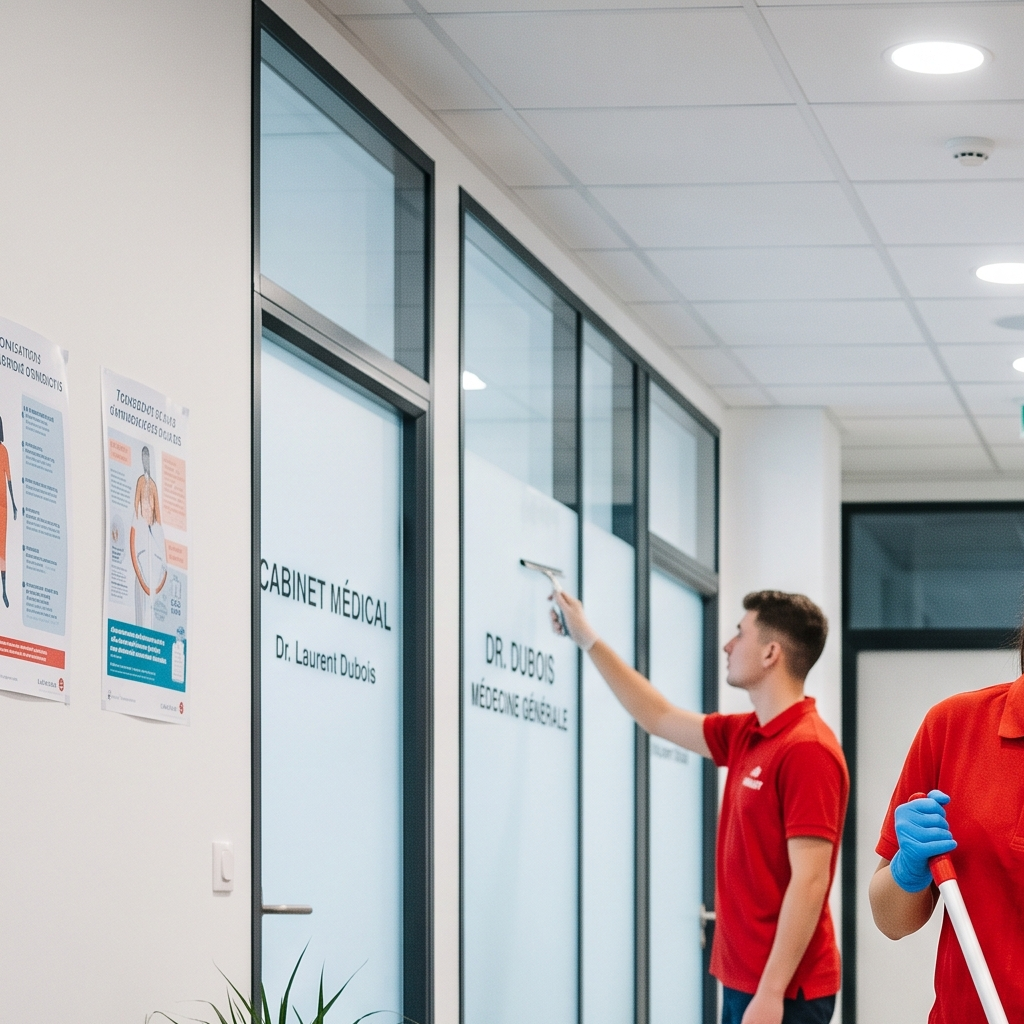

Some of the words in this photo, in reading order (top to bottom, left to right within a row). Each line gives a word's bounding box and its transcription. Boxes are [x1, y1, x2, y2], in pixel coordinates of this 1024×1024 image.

[260, 558, 326, 610] CABINET
[330, 579, 392, 631] MÉDICAL
[276, 634, 291, 662] Dr.
[295, 640, 338, 674] Laurent
[340, 653, 376, 684] Dubois
[486, 632, 507, 669] DR.
[511, 641, 555, 685] DUBOIS
[471, 677, 520, 718] MÉDECINE
[522, 692, 568, 731] GÉNÉRALE
